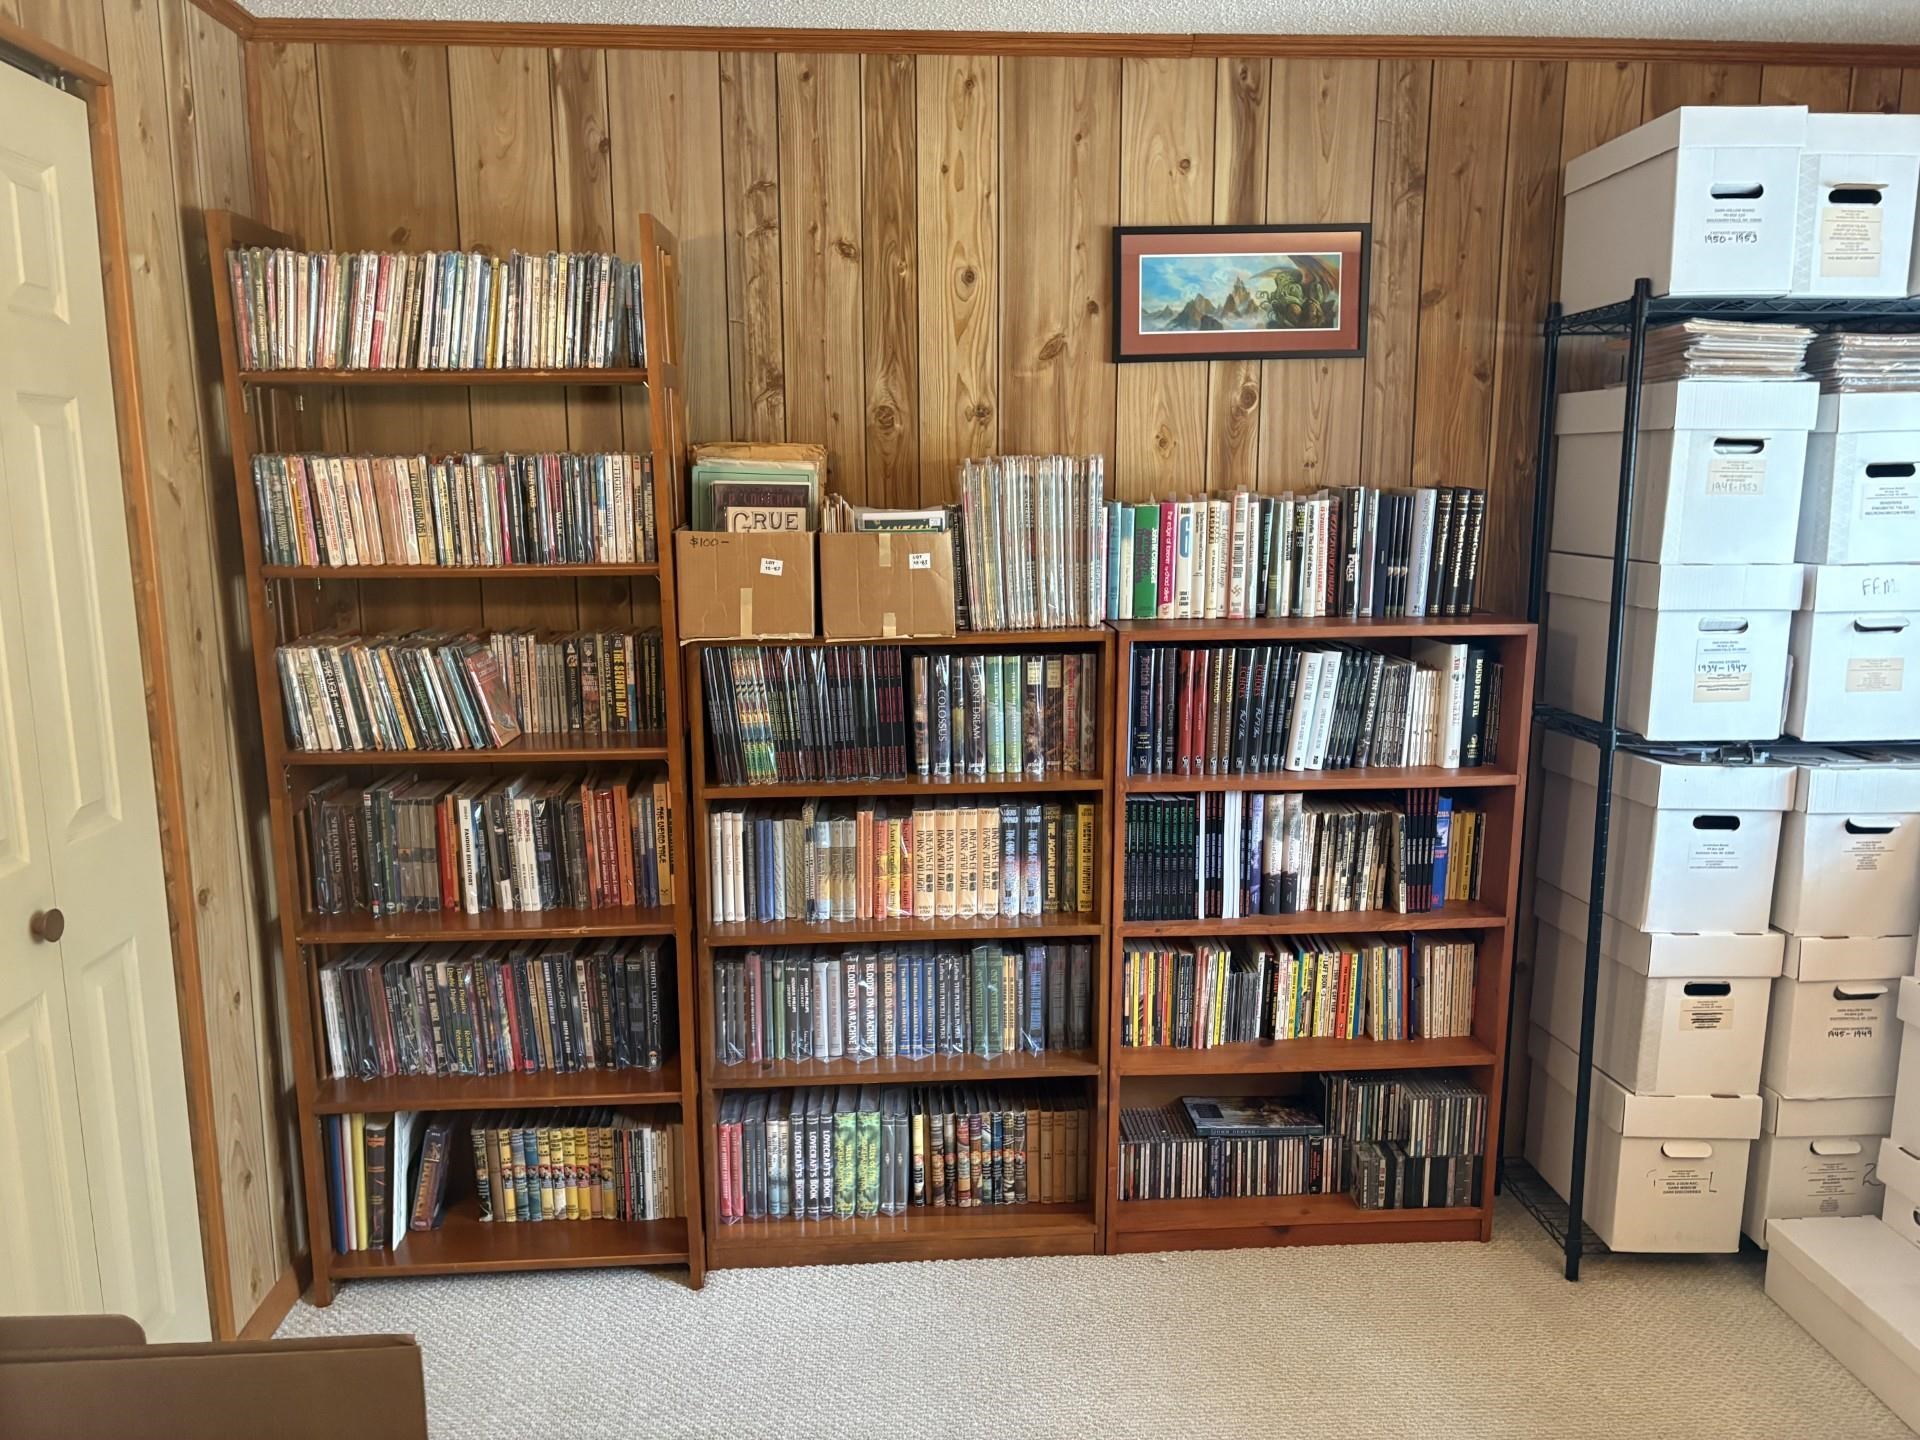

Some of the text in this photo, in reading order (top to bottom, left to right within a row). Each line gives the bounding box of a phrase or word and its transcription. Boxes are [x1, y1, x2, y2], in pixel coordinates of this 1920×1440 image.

[1346, 554, 1358, 581] PALACE
[613, 650, 627, 717] THE SEVENTH DAY
[1475, 659, 1483, 684] BOUND
[937, 690, 946, 741] COLOSSUS
[972, 674, 981, 739] DON'T DREAM
[1365, 667, 1380, 731] SEVEN FOR SPACE
[657, 821, 665, 844] WEIRD
[936, 829, 945, 891] DARK AND LIGHT
[946, 864, 953, 872] OF
[960, 853, 968, 870] AND
[960, 872, 968, 891] LIGHT
[982, 871, 990, 889] LIGHT
[1082, 866, 1092, 894] INFINITY
[556, 962, 564, 988] SHADOW
[848, 965, 857, 1044] BLOODED ON ARACHNE
[866, 963, 874, 1043] BLOODED ON ARACHNE
[885, 963, 893, 1043] BLOODED ON ARACHNE
[794, 1132, 803, 1177] LOVECRAFT'S
[809, 1132, 817, 1177] LOVECRAFT'S
[823, 1130, 831, 1198] LOVECRAFT'S BOOK
